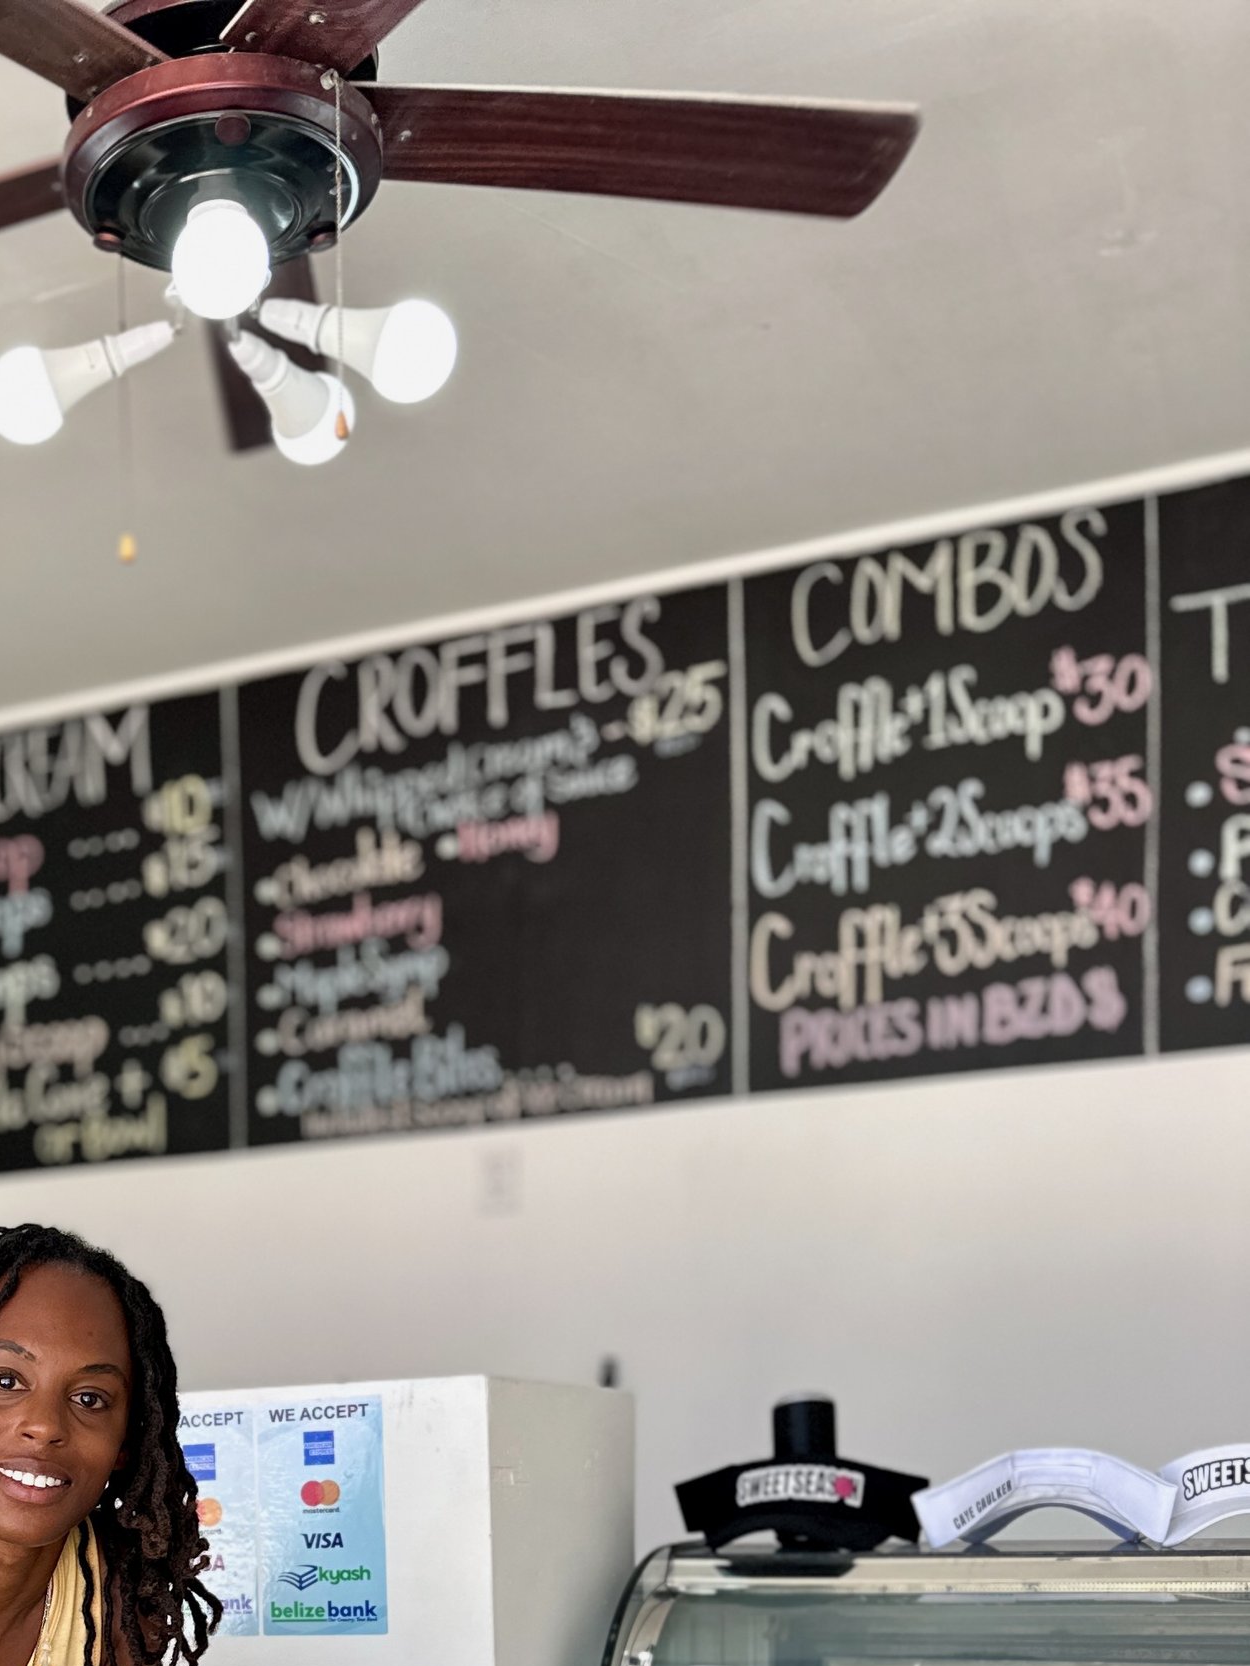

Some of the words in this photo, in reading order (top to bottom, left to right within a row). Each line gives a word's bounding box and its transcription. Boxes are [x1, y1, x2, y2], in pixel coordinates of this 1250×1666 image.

[791, 506, 1108, 667] COMBOS
[296, 596, 667, 776] CROFFLES
[626, 659, 727, 746] $25
[1050, 645, 1152, 726] $30
[1064, 754, 1152, 831] $35
[1069, 877, 1151, 938] $40
[633, 1002, 726, 1072] $20
[780, 999, 924, 1077] PRICES
[926, 992, 980, 1050] IN
[179, 1411, 244, 1428] ACCEPT
[269, 1408, 296, 1423] WE
[299, 1403, 369, 1421] ACCEPT
[953, 1505, 976, 1530] CAYE
[975, 1479, 1013, 1514] CAULKER
[302, 1532, 344, 1549] VISA
[318, 1565, 371, 1585] kyash
[271, 1601, 326, 1618] belize
[327, 1600, 378, 1617] bank
